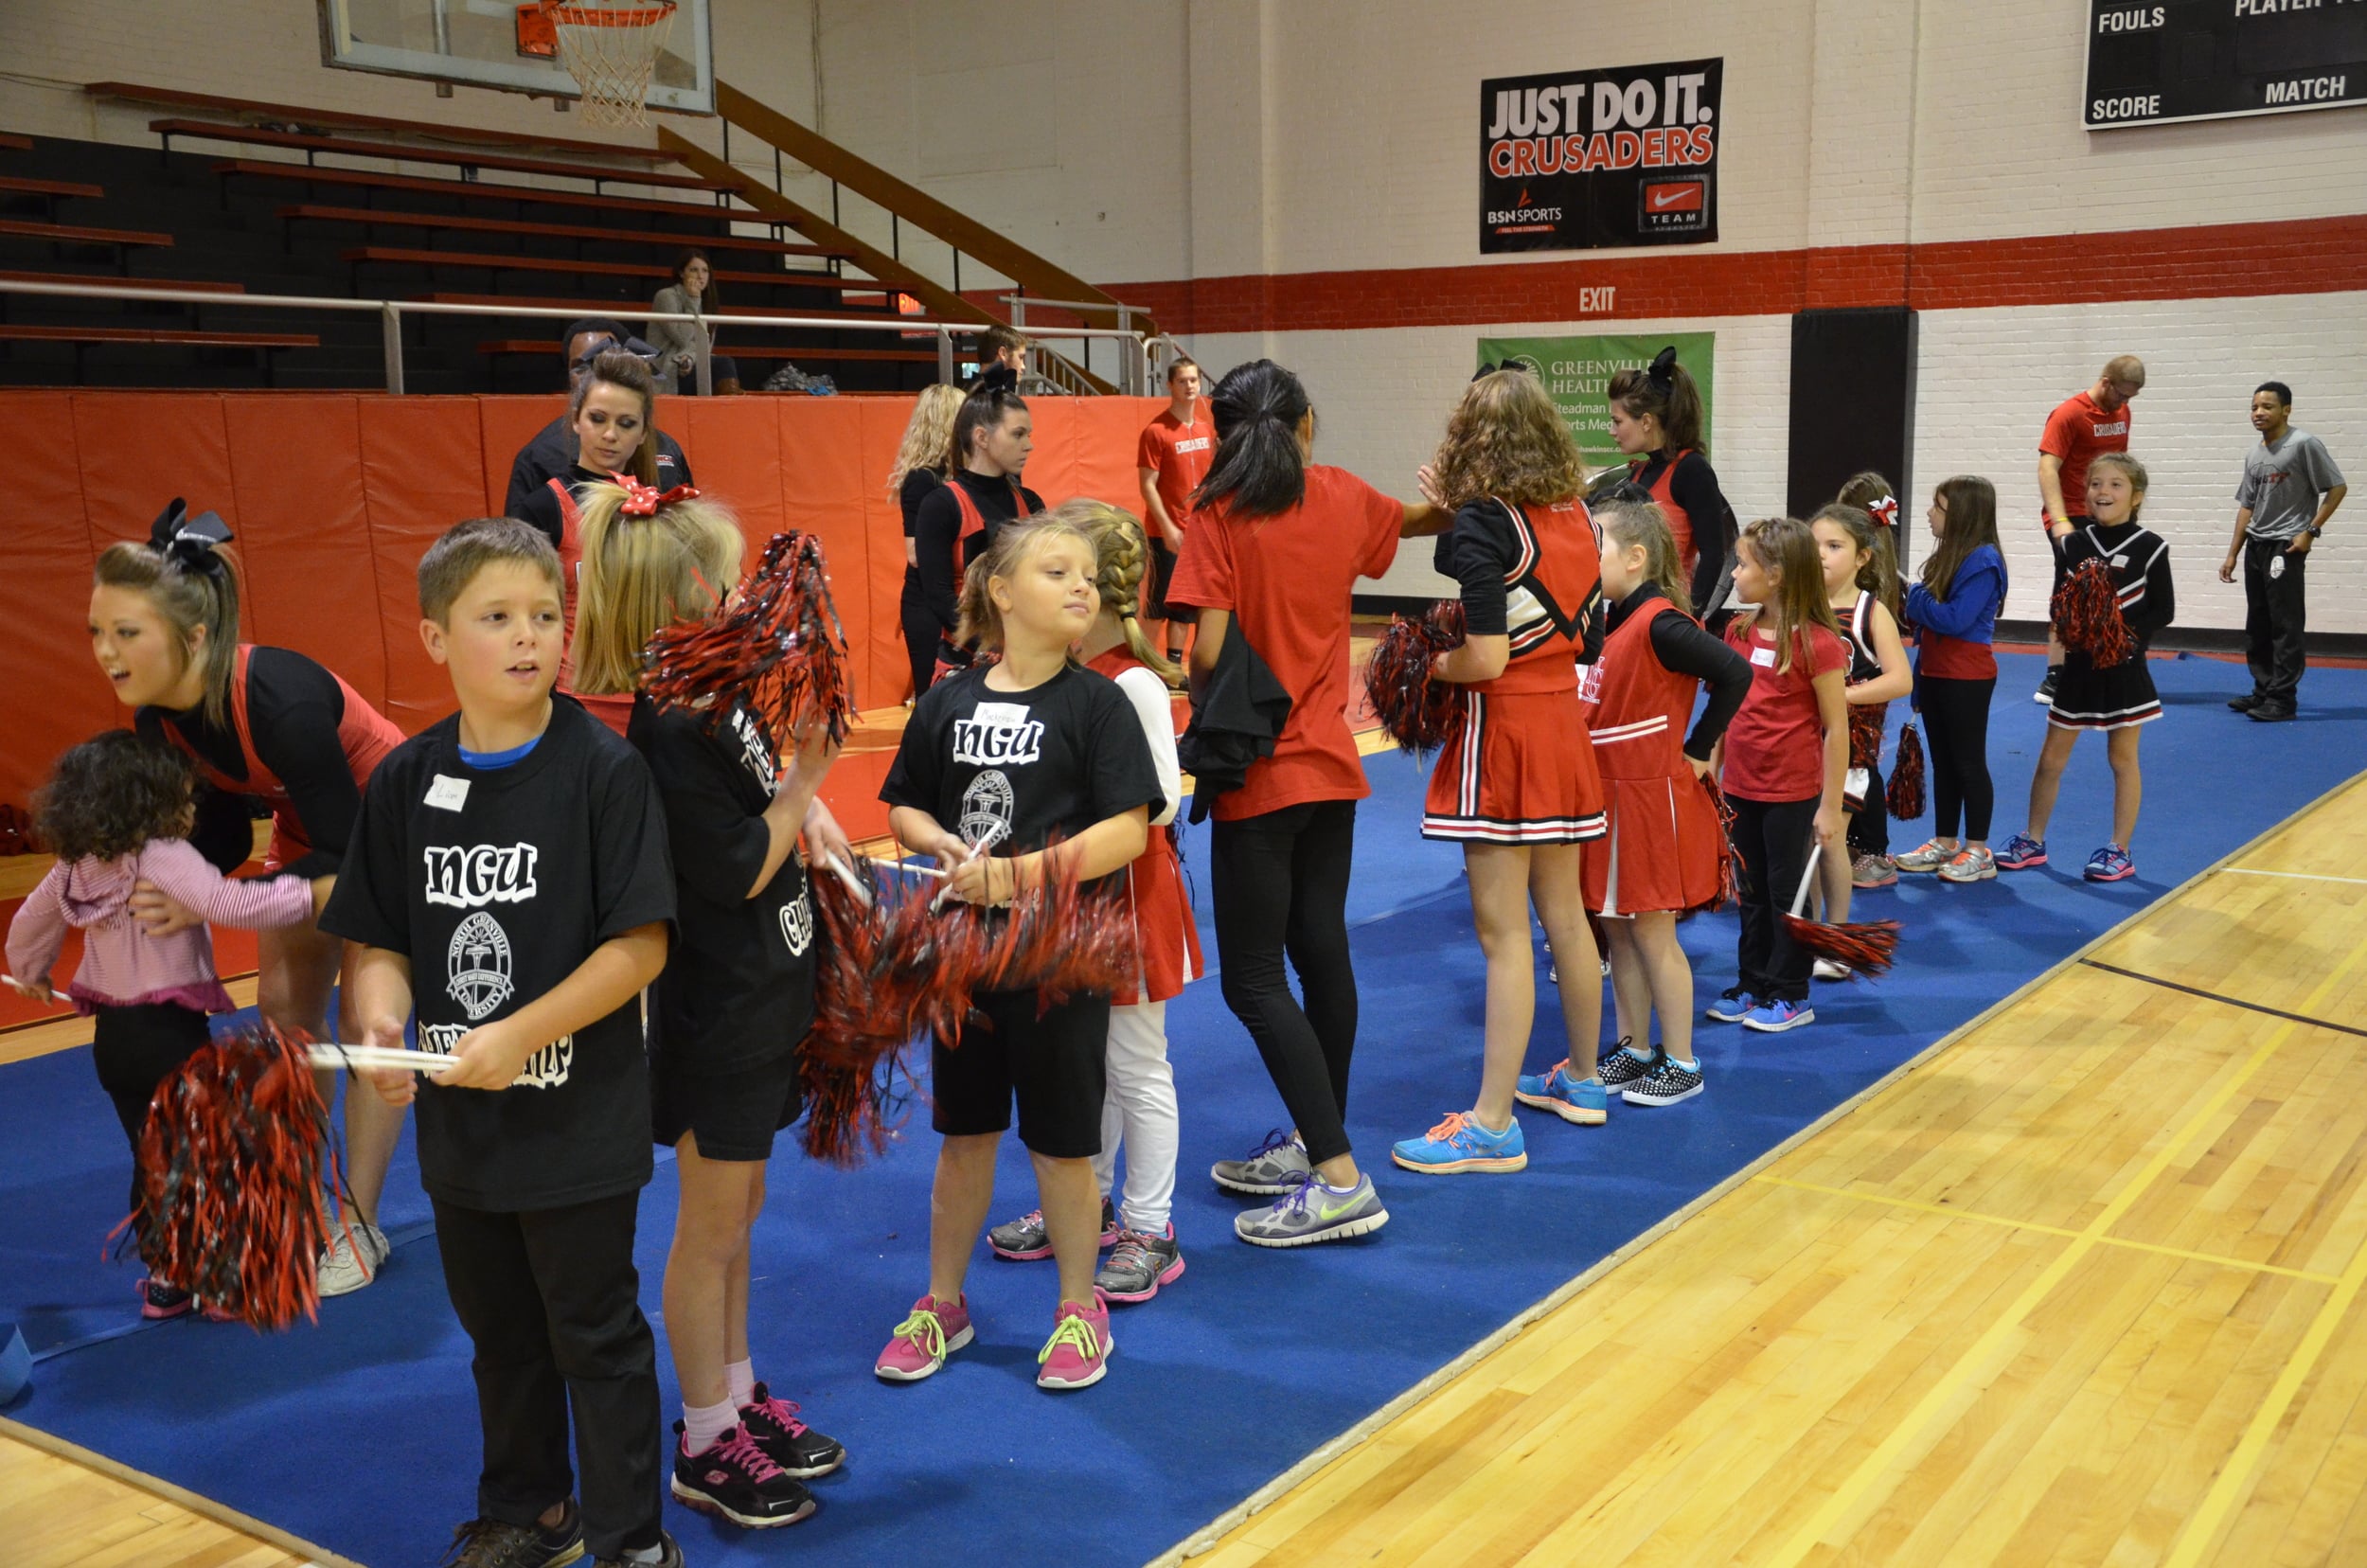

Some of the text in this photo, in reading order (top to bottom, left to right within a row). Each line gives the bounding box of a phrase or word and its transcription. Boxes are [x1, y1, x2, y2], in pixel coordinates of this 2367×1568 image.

[2098, 7, 2165, 33] FOULS
[2265, 76, 2346, 103] MATCH
[1488, 72, 1714, 140] JUST DO IT.
[2092, 95, 2161, 120] SCORE
[1488, 124, 1714, 178] CRUSADERS
[1487, 207, 1562, 223] BSN SPORTS
[1651, 214, 1696, 223] TEAM
[1579, 287, 1615, 312] EXIT
[452, 921, 472, 957] NORTH
